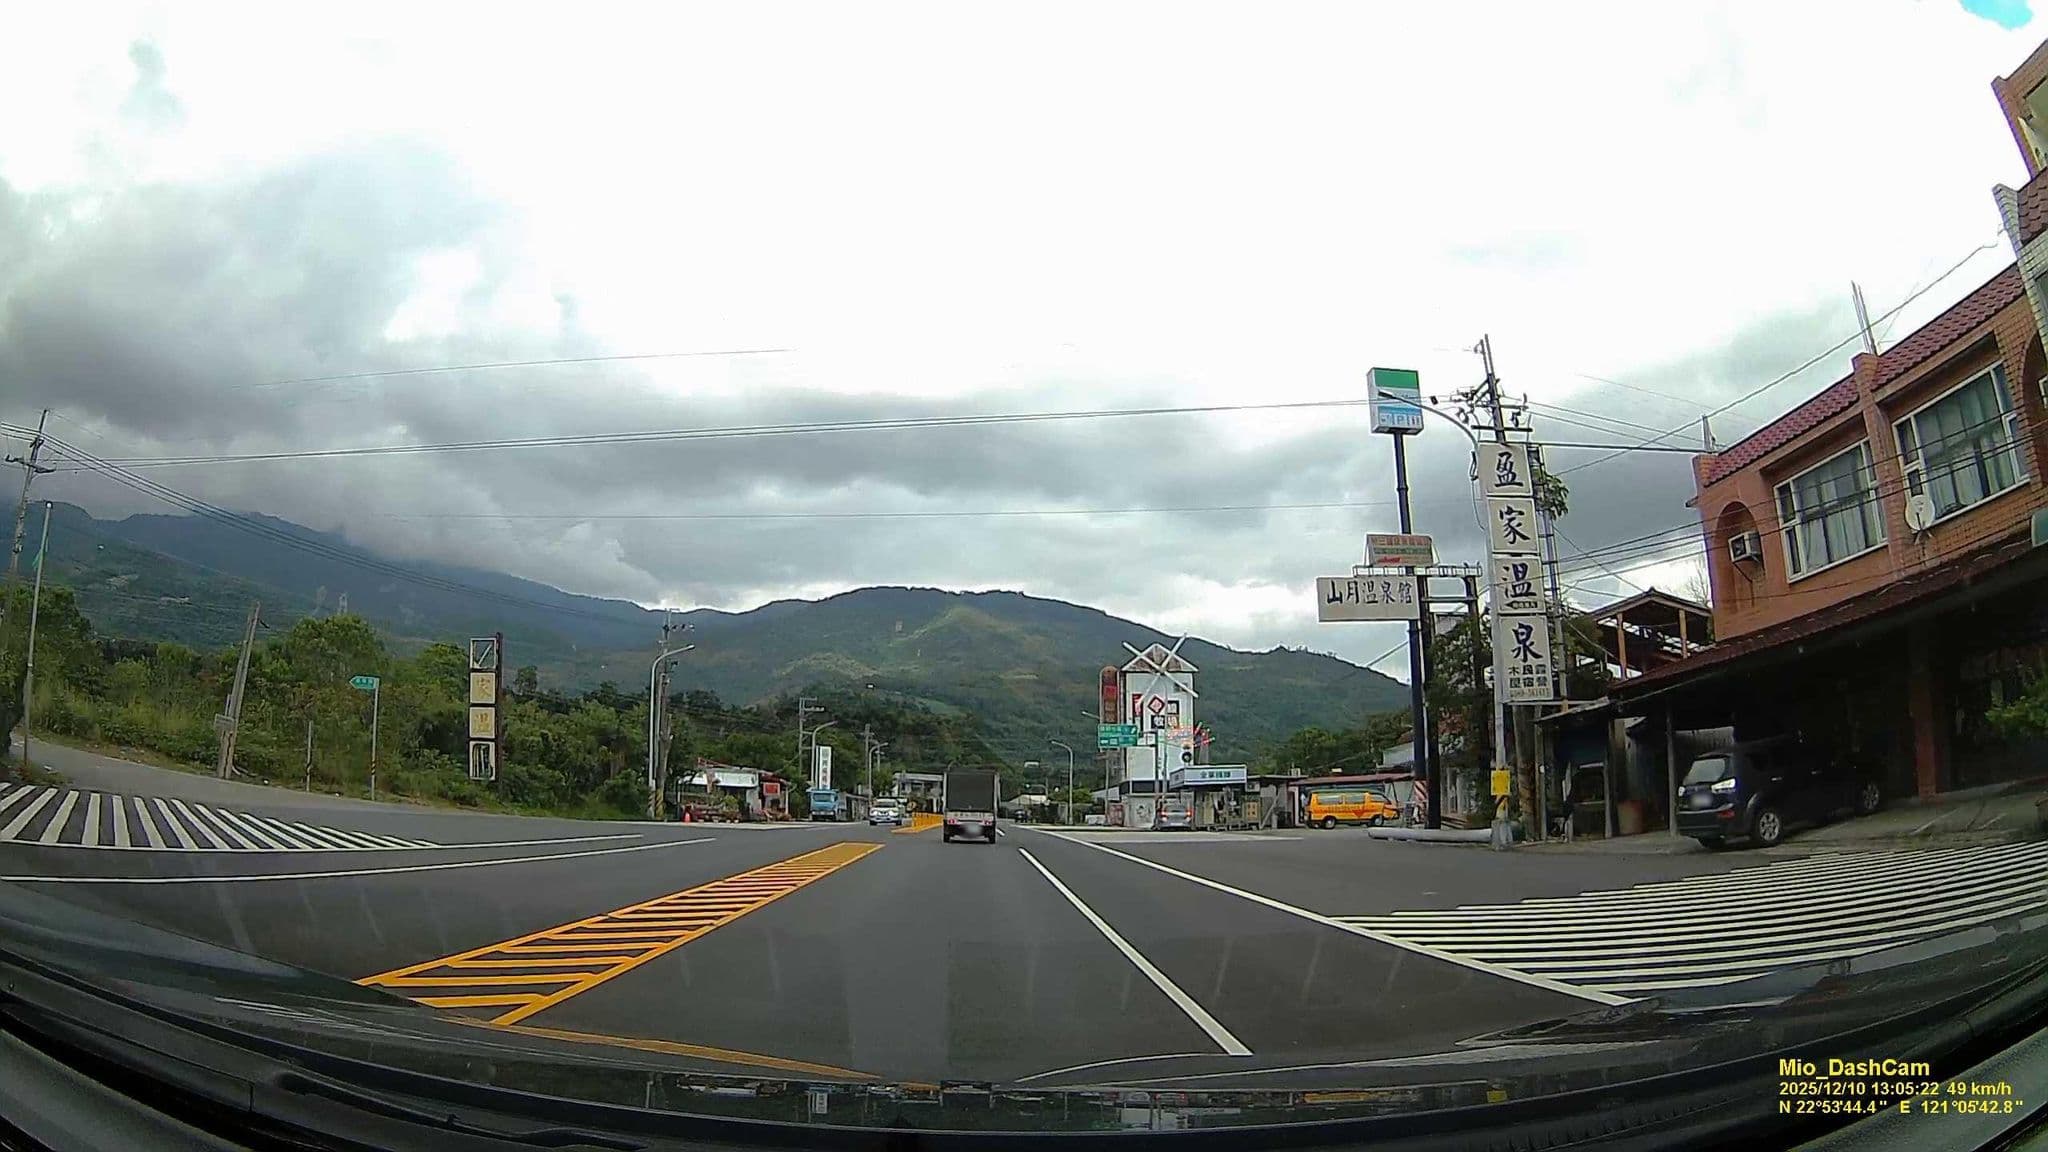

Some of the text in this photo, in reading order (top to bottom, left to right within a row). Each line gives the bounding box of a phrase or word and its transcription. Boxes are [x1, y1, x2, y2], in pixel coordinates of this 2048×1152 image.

[1326, 580, 1413, 604] 山月溫泉館
[1494, 451, 1544, 663] 盈家溫泉
